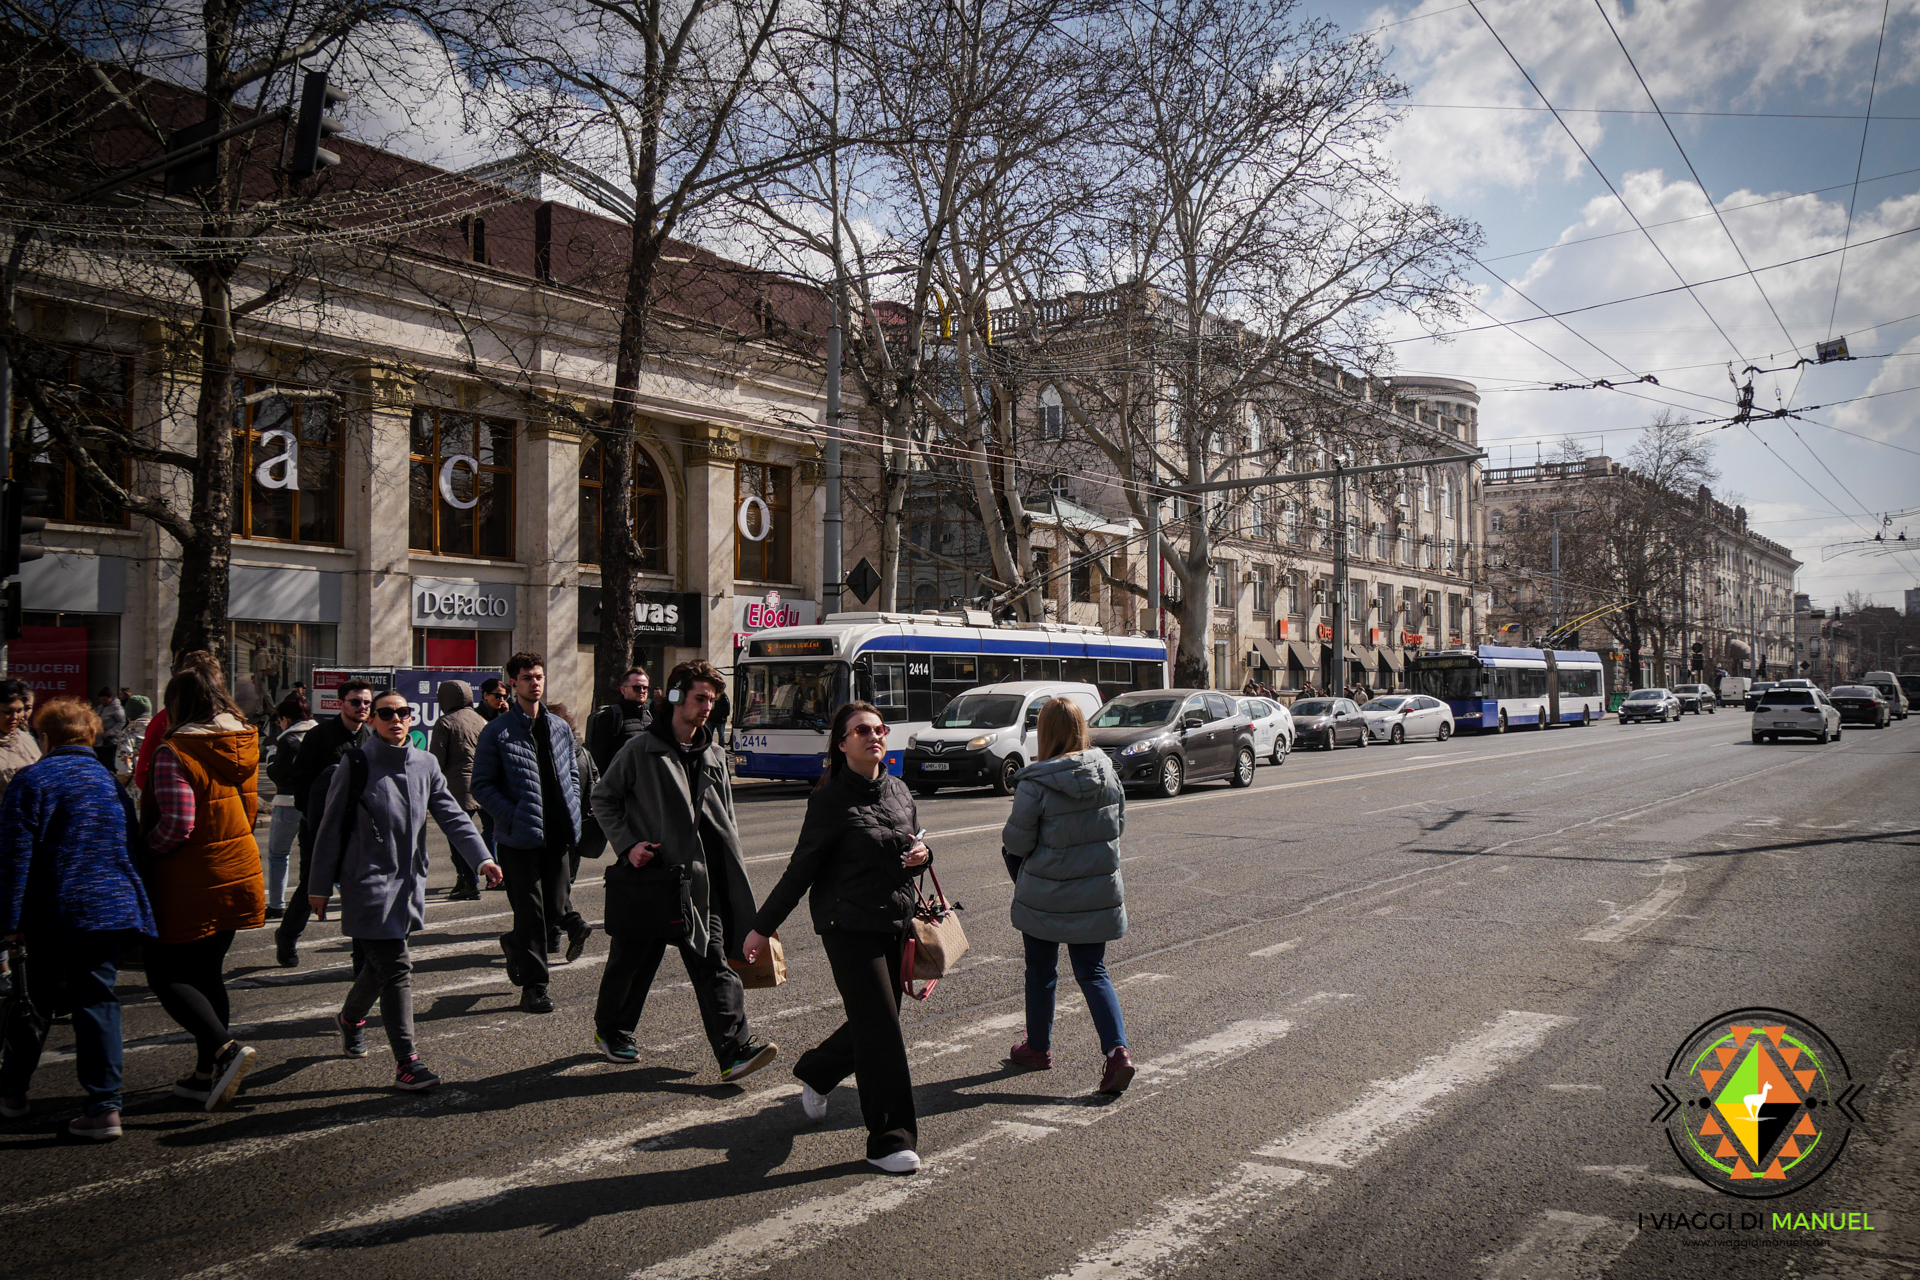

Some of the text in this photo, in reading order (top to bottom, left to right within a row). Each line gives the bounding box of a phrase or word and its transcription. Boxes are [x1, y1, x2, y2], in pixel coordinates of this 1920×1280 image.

[422, 590, 509, 617] DeFacto
[634, 602, 679, 624] vas
[655, 624, 677, 632] familie
[1317, 622, 1333, 639] Ora
[1401, 630, 1424, 647] Orange
[8, 663, 80, 674] EDUCERI
[909, 662, 929, 675] 2414
[25, 680, 67, 690] NALE
[741, 735, 768, 747] 2414
